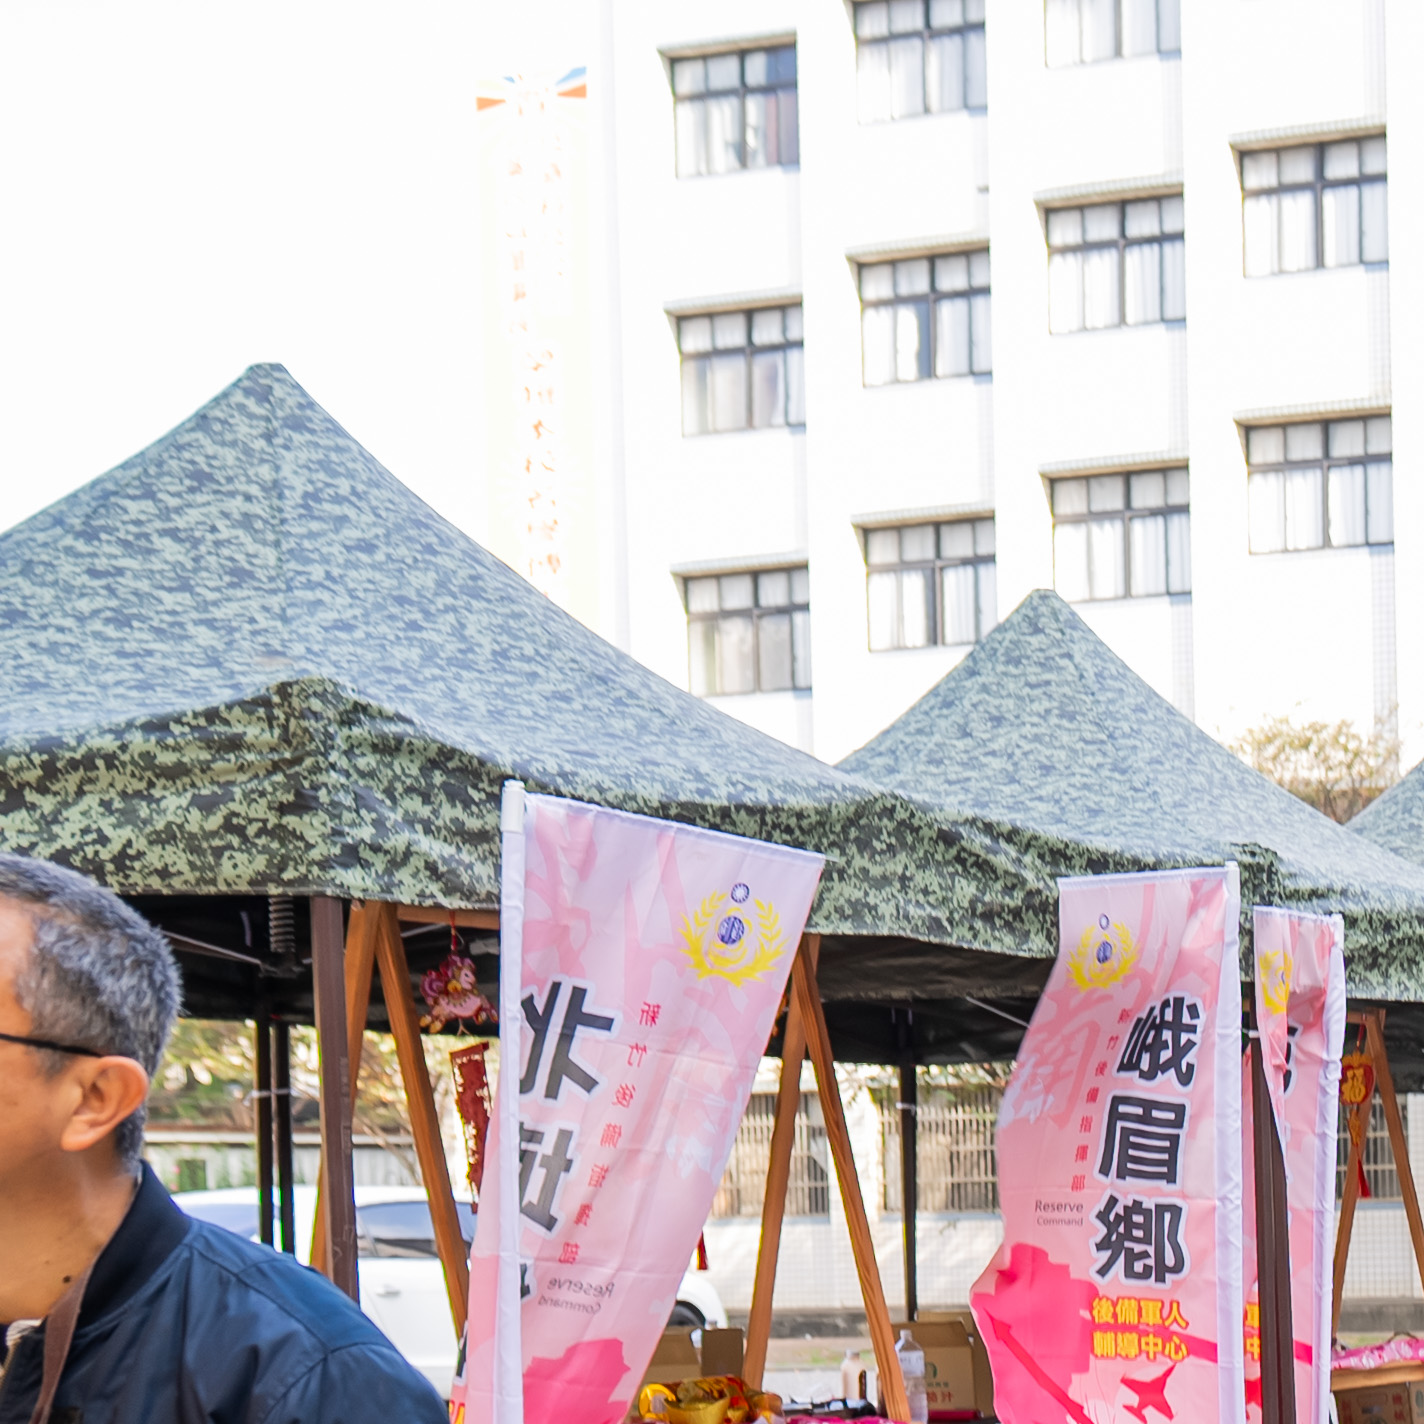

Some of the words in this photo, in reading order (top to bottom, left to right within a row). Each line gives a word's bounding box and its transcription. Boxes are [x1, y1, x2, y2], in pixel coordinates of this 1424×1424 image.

[1095, 996, 1200, 1284] 峨眉鄉
[1034, 1200, 1084, 1214] Reserve
[1036, 1216, 1084, 1227] Command
[1091, 1296, 1190, 1330] 後備軍人
[1092, 1331, 1189, 1362] 輔導中心
